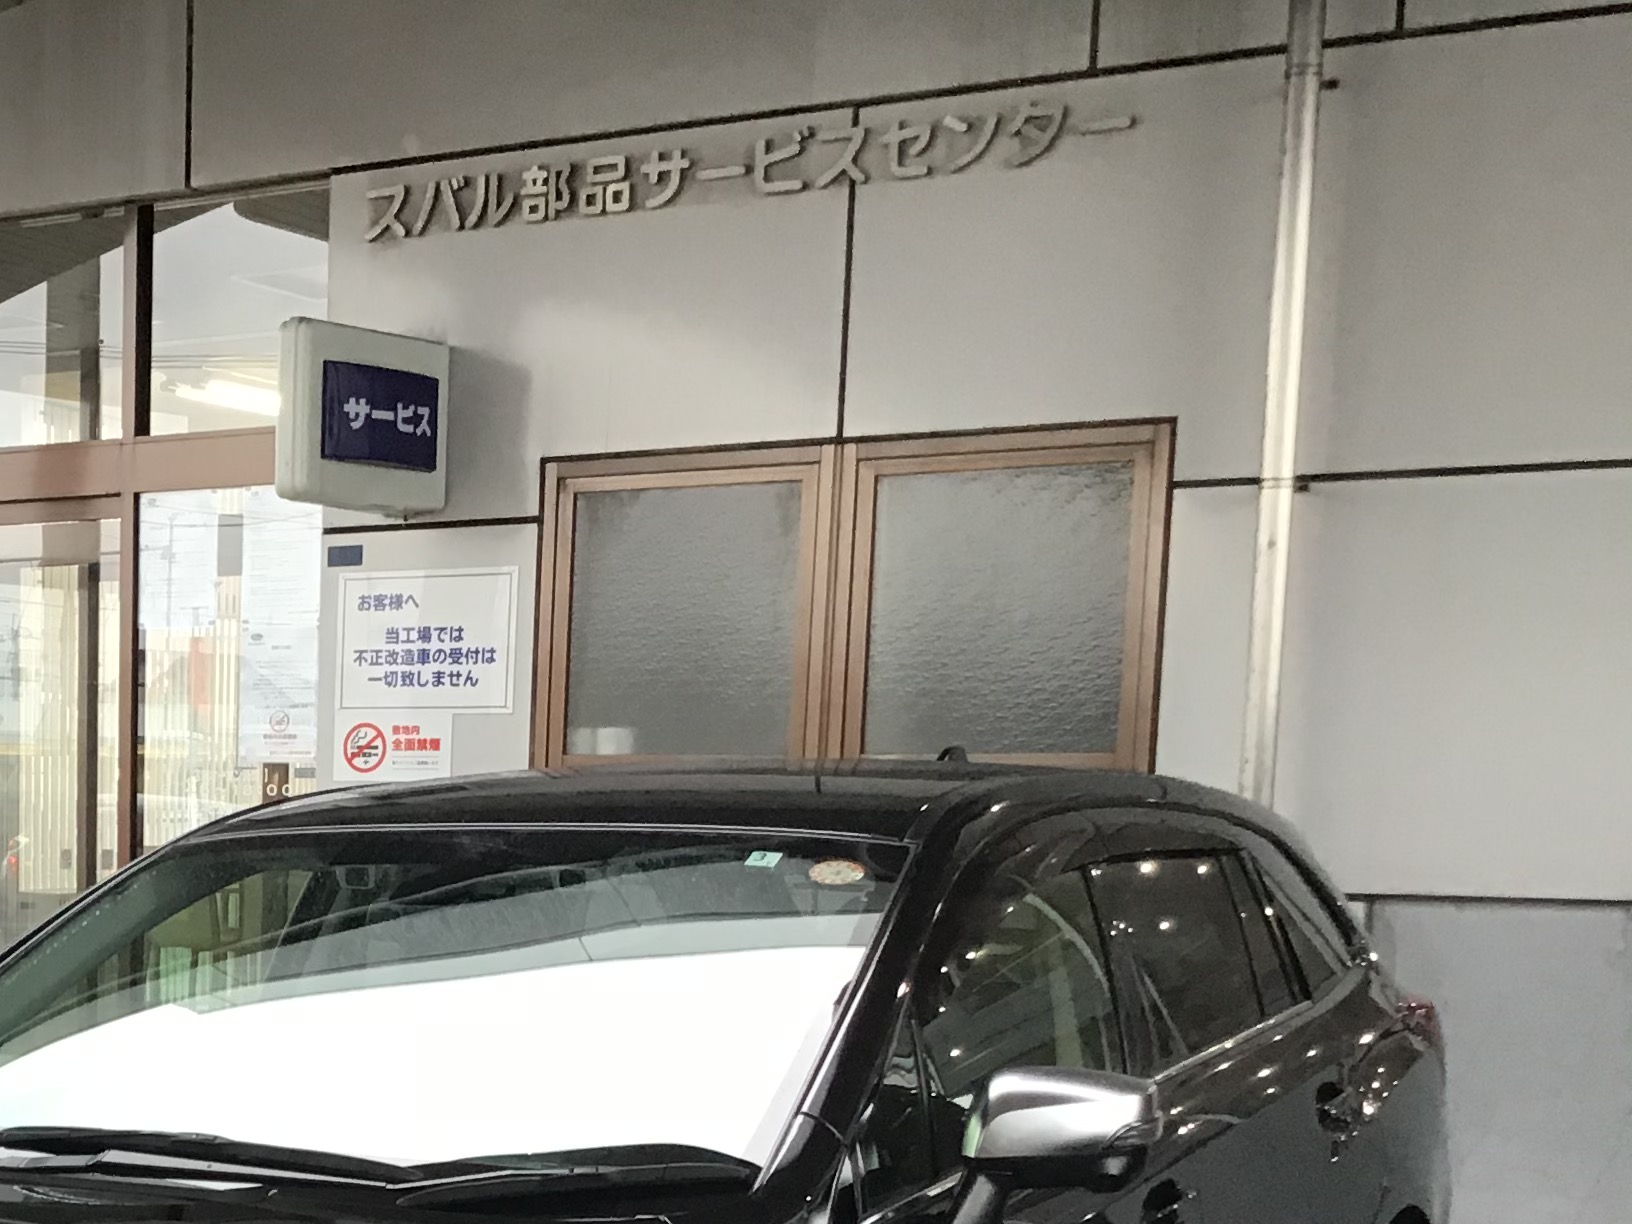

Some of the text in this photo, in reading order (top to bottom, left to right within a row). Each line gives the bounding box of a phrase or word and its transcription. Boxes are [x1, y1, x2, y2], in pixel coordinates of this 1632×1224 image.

[366, 100, 1139, 243] スバル部品サービスセンター
[343, 397, 431, 437] サービス
[357, 593, 419, 612] お客様へ
[385, 625, 464, 645] 当工場では
[353, 647, 497, 667] 不正改造車の受付は
[367, 669, 479, 689] 一切致しません
